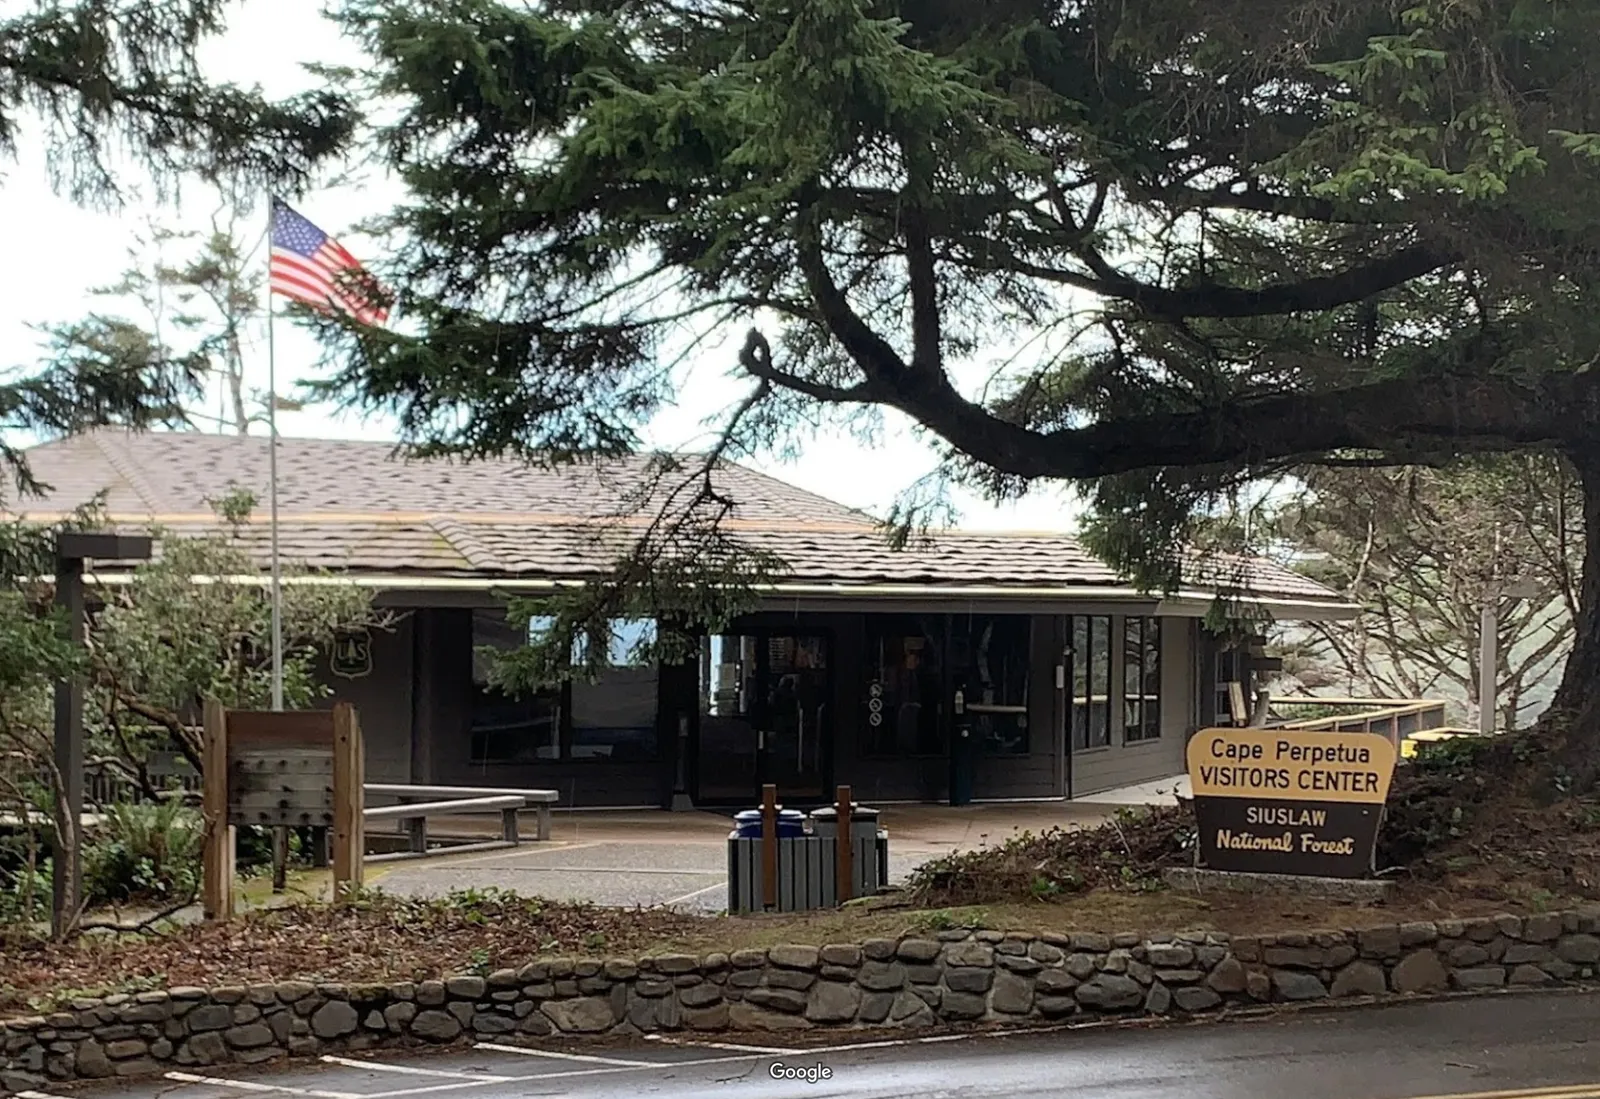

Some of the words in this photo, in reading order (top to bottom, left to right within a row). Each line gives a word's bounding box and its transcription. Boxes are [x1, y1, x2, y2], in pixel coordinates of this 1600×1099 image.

[1211, 738, 1263, 762] Cape
[1275, 740, 1370, 765] Perpetua
[1200, 765, 1290, 788] VISITORS
[1297, 770, 1379, 793] CENTER
[1246, 806, 1327, 826] SIUSLAW
[1216, 829, 1294, 853] National
[1300, 833, 1355, 855] Forest
